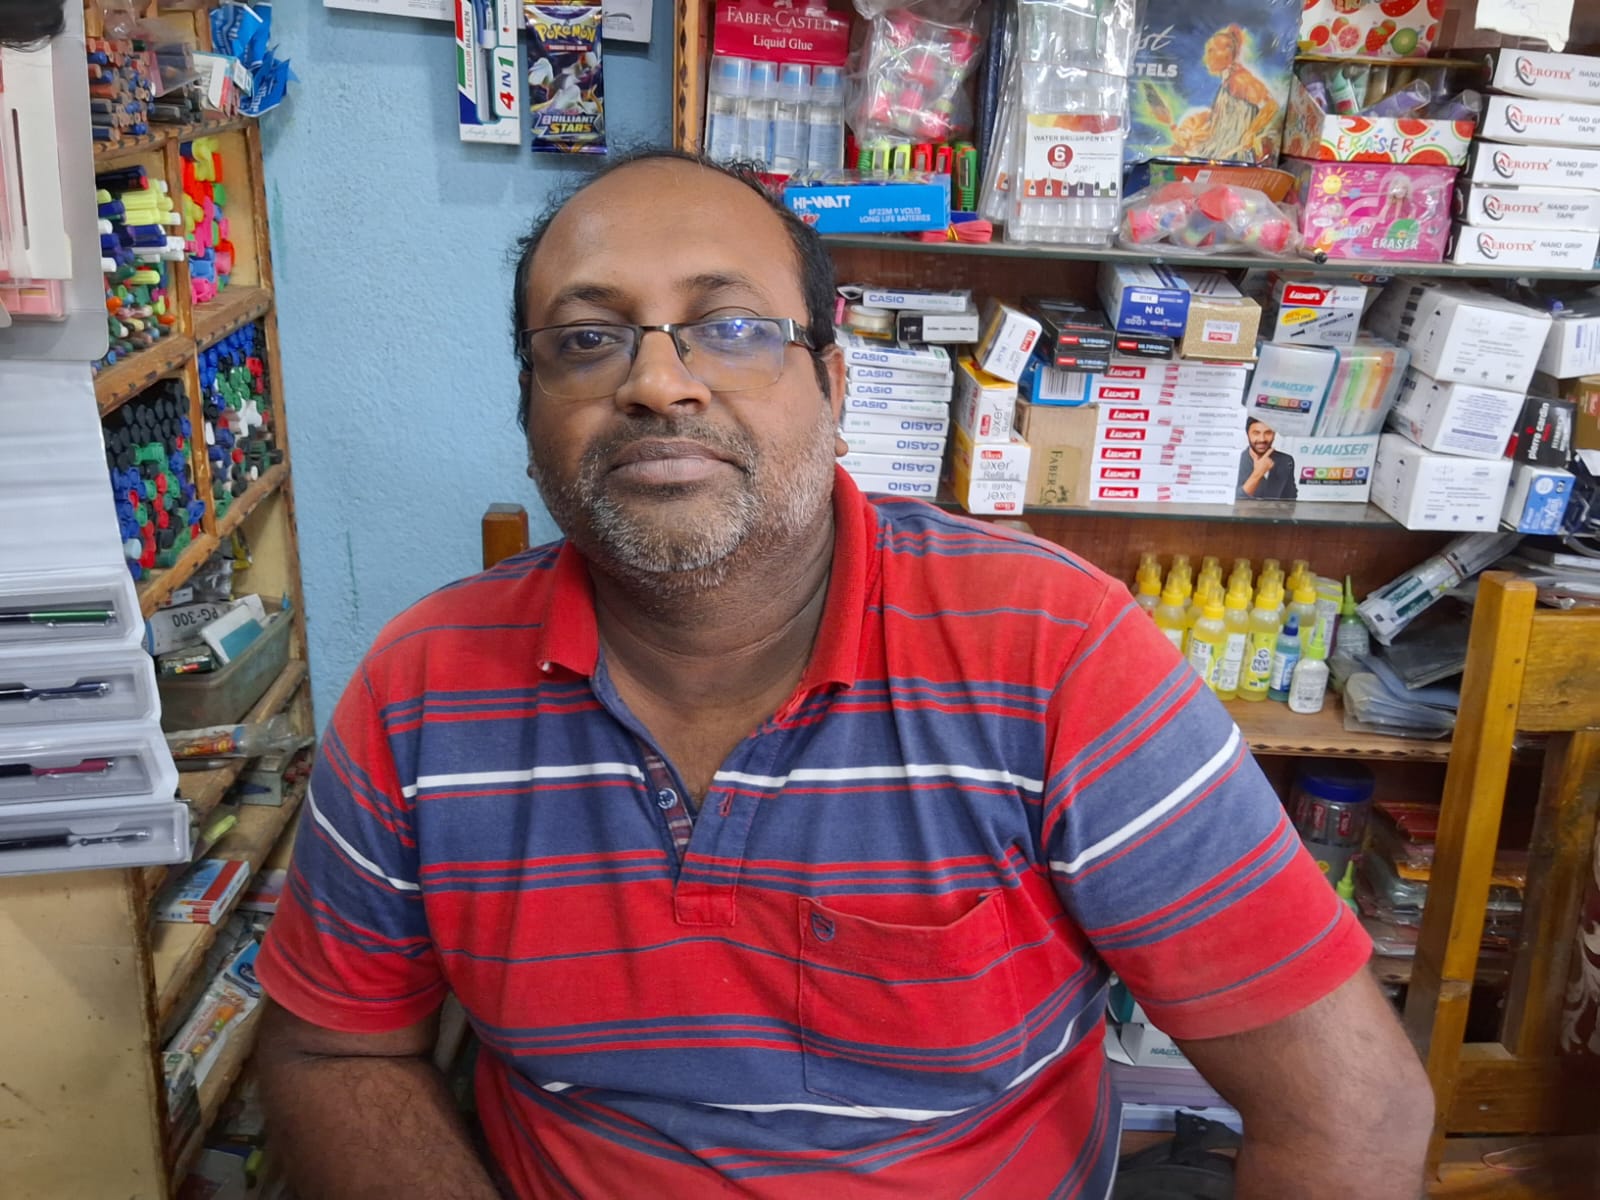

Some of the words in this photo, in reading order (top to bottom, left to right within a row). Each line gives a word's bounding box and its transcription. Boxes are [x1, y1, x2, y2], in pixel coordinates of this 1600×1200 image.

[753, 35, 786, 49] Liquid
[788, 38, 813, 51] Glue
[498, 56, 514, 68] 1
[1519, 63, 1572, 80] AEROTIX
[502, 70, 511, 88] IN
[499, 92, 514, 110] 4
[541, 115, 595, 124] BRILLIANT
[1509, 110, 1561, 126] AEROTIX
[1568, 115, 1590, 123] NANO
[550, 122, 592, 133] STARS
[1337, 134, 1415, 153] ERASER
[1054, 145, 1067, 162] 6
[1497, 157, 1550, 171] AEROTIX
[1556, 160, 1578, 168] NANO
[1579, 161, 1598, 169] GRIP
[793, 195, 851, 209] HI-WATT
[1487, 201, 1540, 214] AEROTIX
[1547, 203, 1569, 211] NANO
[1571, 204, 1589, 212] GRIP
[901, 207, 922, 215] VOLTS
[859, 215, 880, 223] LONG
[881, 215, 896, 223] LIFE
[897, 214, 931, 223] BATTERIES
[1372, 237, 1419, 250] ERASER
[1481, 239, 1534, 252] AEROTIX
[1540, 241, 1562, 249] NANO
[868, 294, 905, 304] CASIO
[851, 351, 889, 363] CASIO
[857, 369, 893, 378] CASIO
[856, 385, 893, 394] CASIO
[1270, 381, 1315, 393] HAUSER
[851, 399, 888, 410] CASIO
[1535, 402, 1550, 432] cardin
[900, 420, 944, 432] CASIO
[896, 439, 940, 451] CASIO
[1311, 443, 1369, 456] HAUSER
[891, 461, 936, 473] CASIO
[1301, 467, 1367, 480] COMBO
[1043, 450, 1063, 507] FABER-CA
[887, 481, 932, 493] CASIO
[171, 607, 219, 628] PG-300
